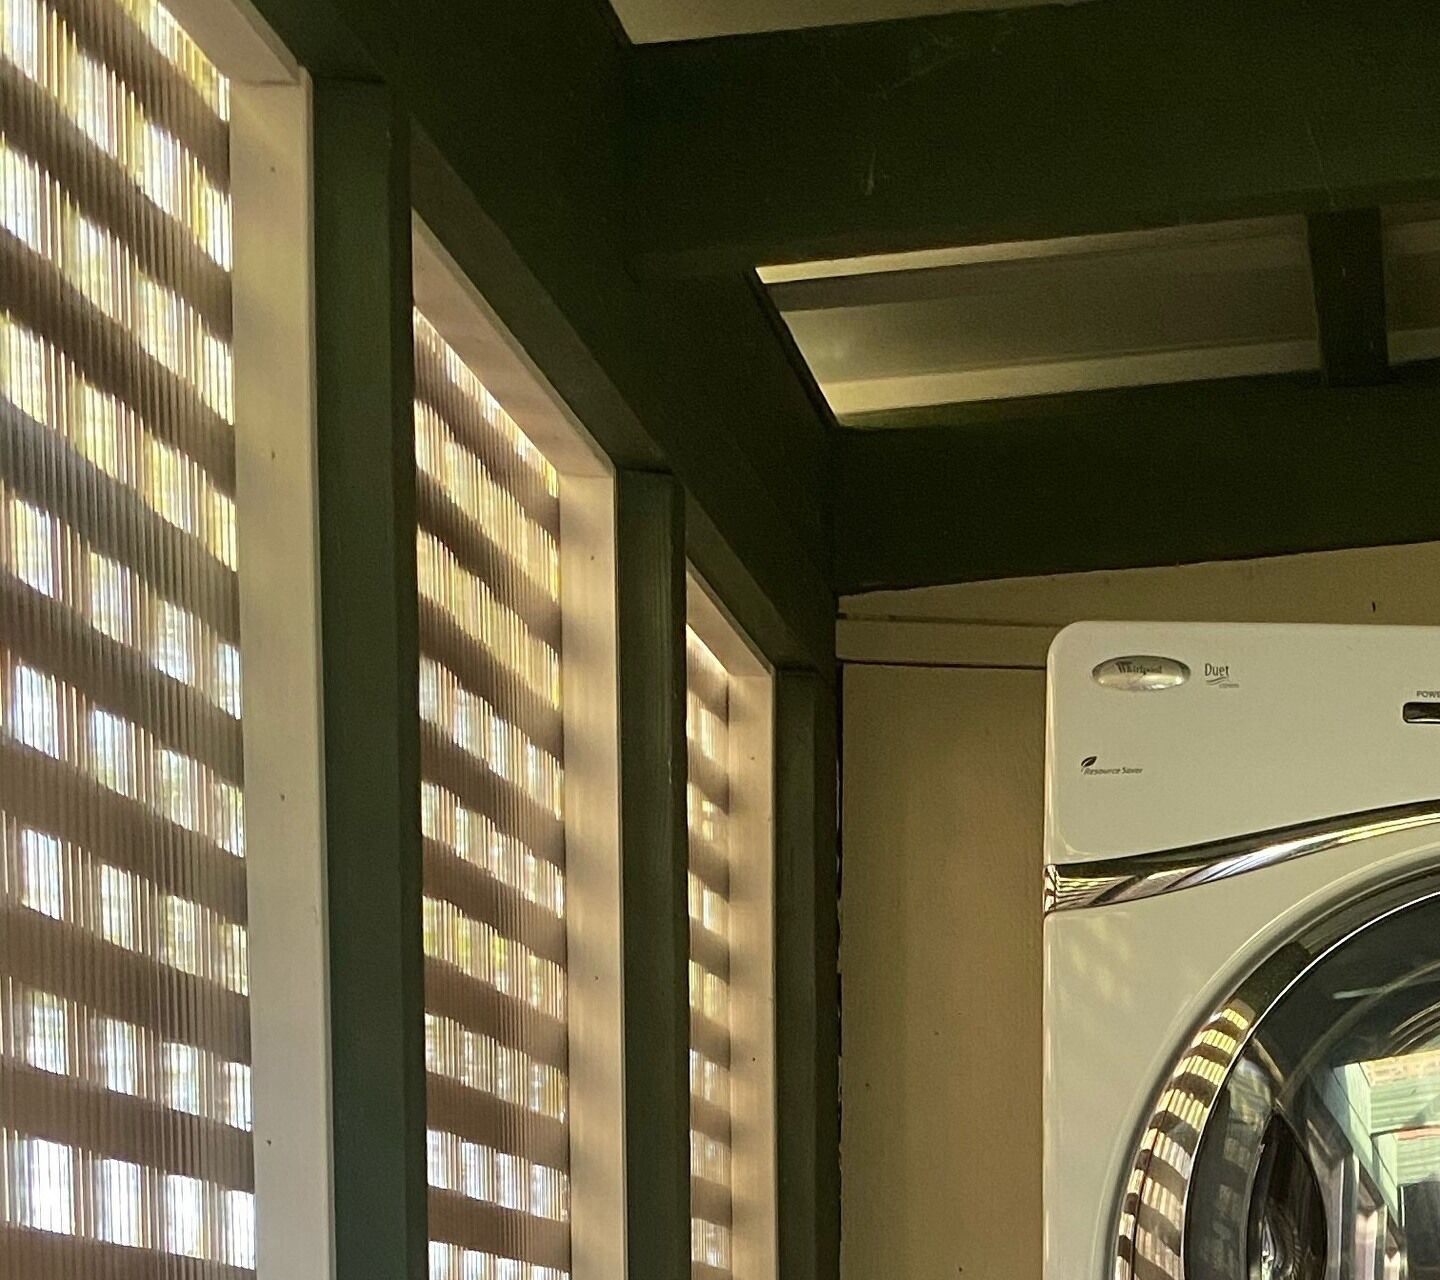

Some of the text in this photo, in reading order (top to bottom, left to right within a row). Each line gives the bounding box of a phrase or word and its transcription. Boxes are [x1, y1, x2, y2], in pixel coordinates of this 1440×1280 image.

[1204, 663, 1230, 677] Duet
[1083, 767, 1143, 776] Resource Saver
